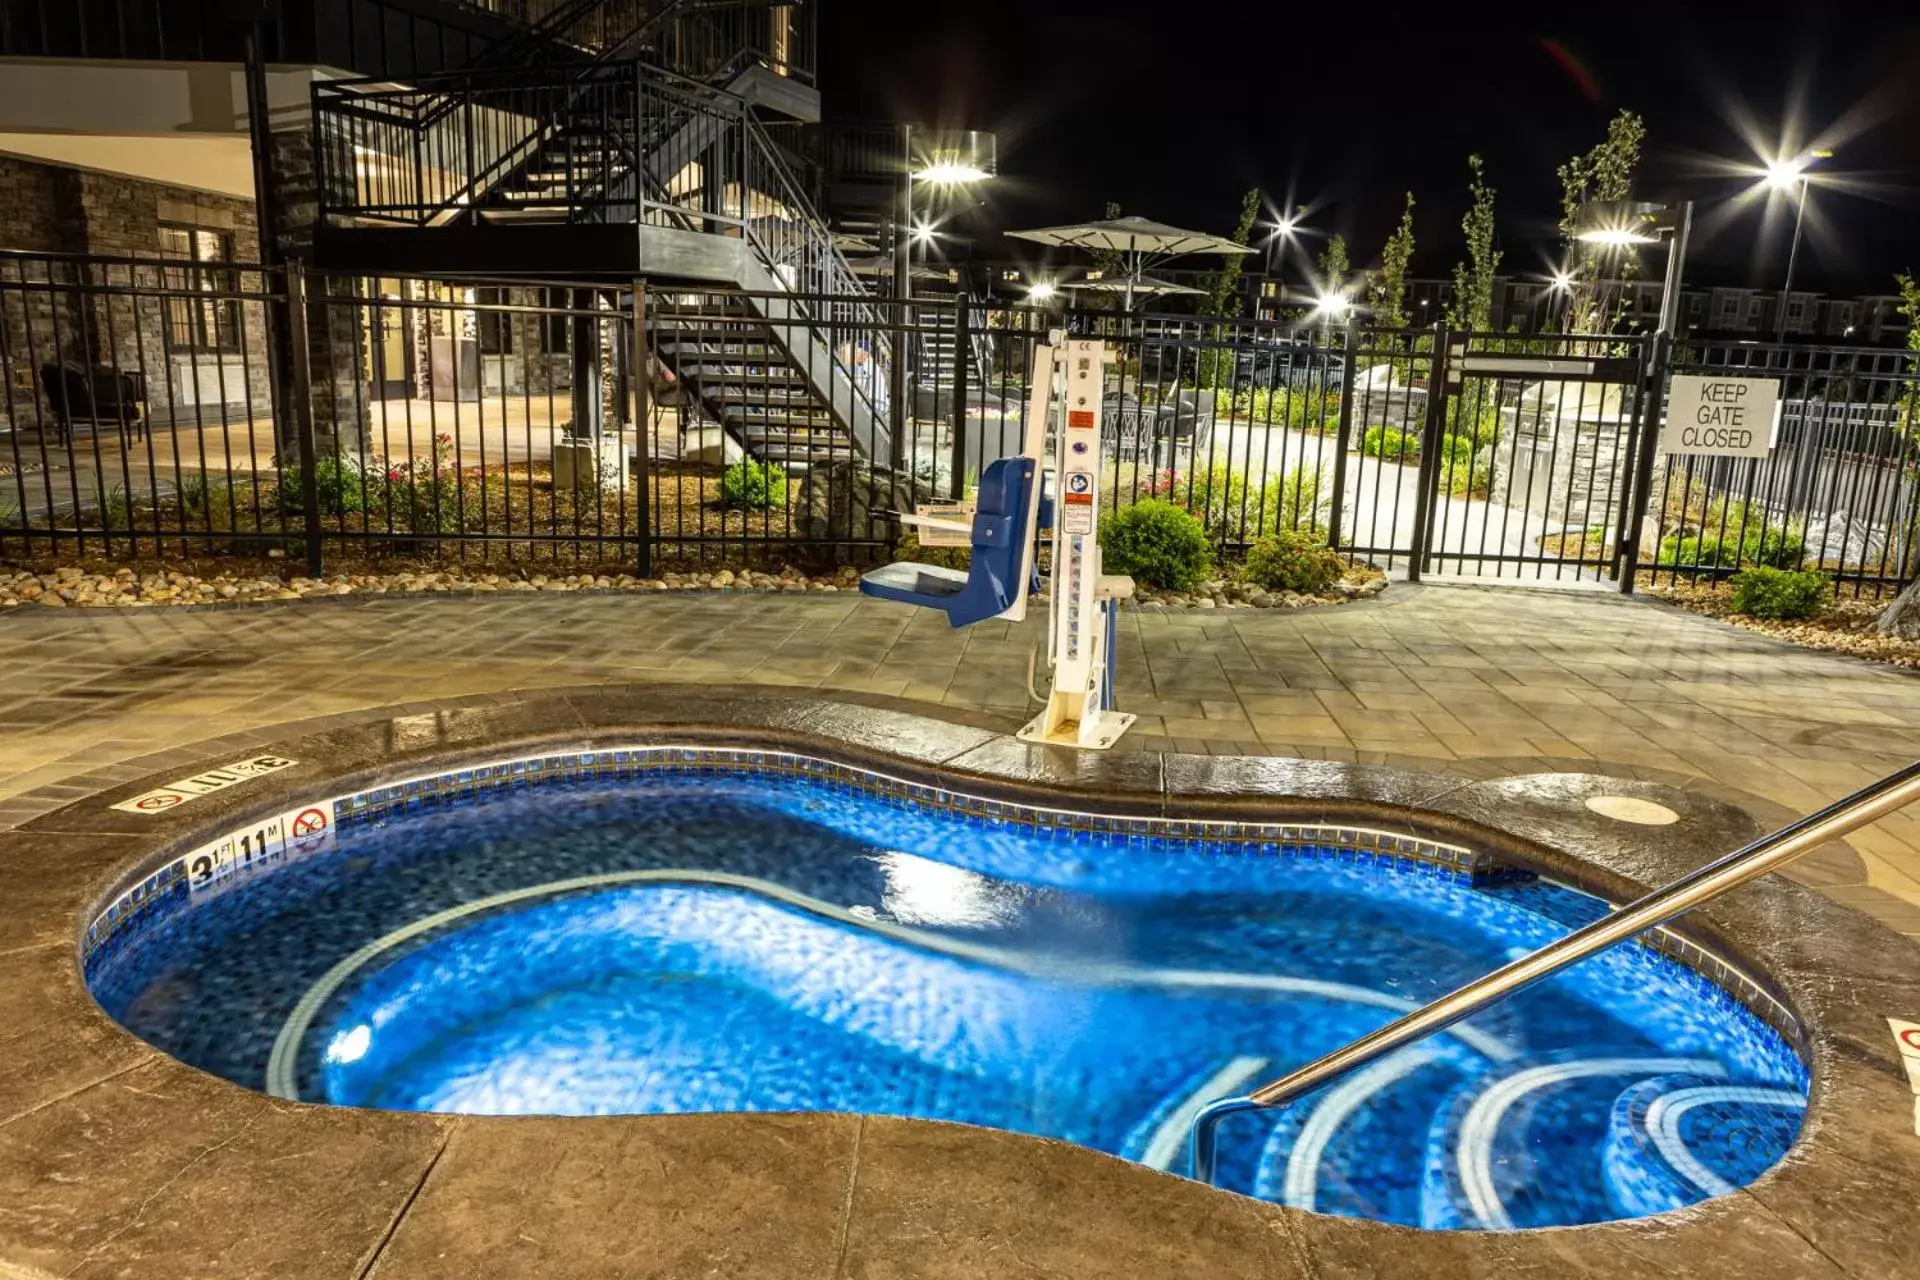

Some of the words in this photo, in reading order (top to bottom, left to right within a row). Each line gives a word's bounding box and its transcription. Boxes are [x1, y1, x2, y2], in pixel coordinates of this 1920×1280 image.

[1079, 342, 1091, 350] CE
[1700, 383, 1748, 403] KEEP
[1696, 405, 1745, 426] GATE
[1681, 427, 1752, 448] CLOSED
[268, 824, 277, 837] M
[191, 855, 213, 886] 3
